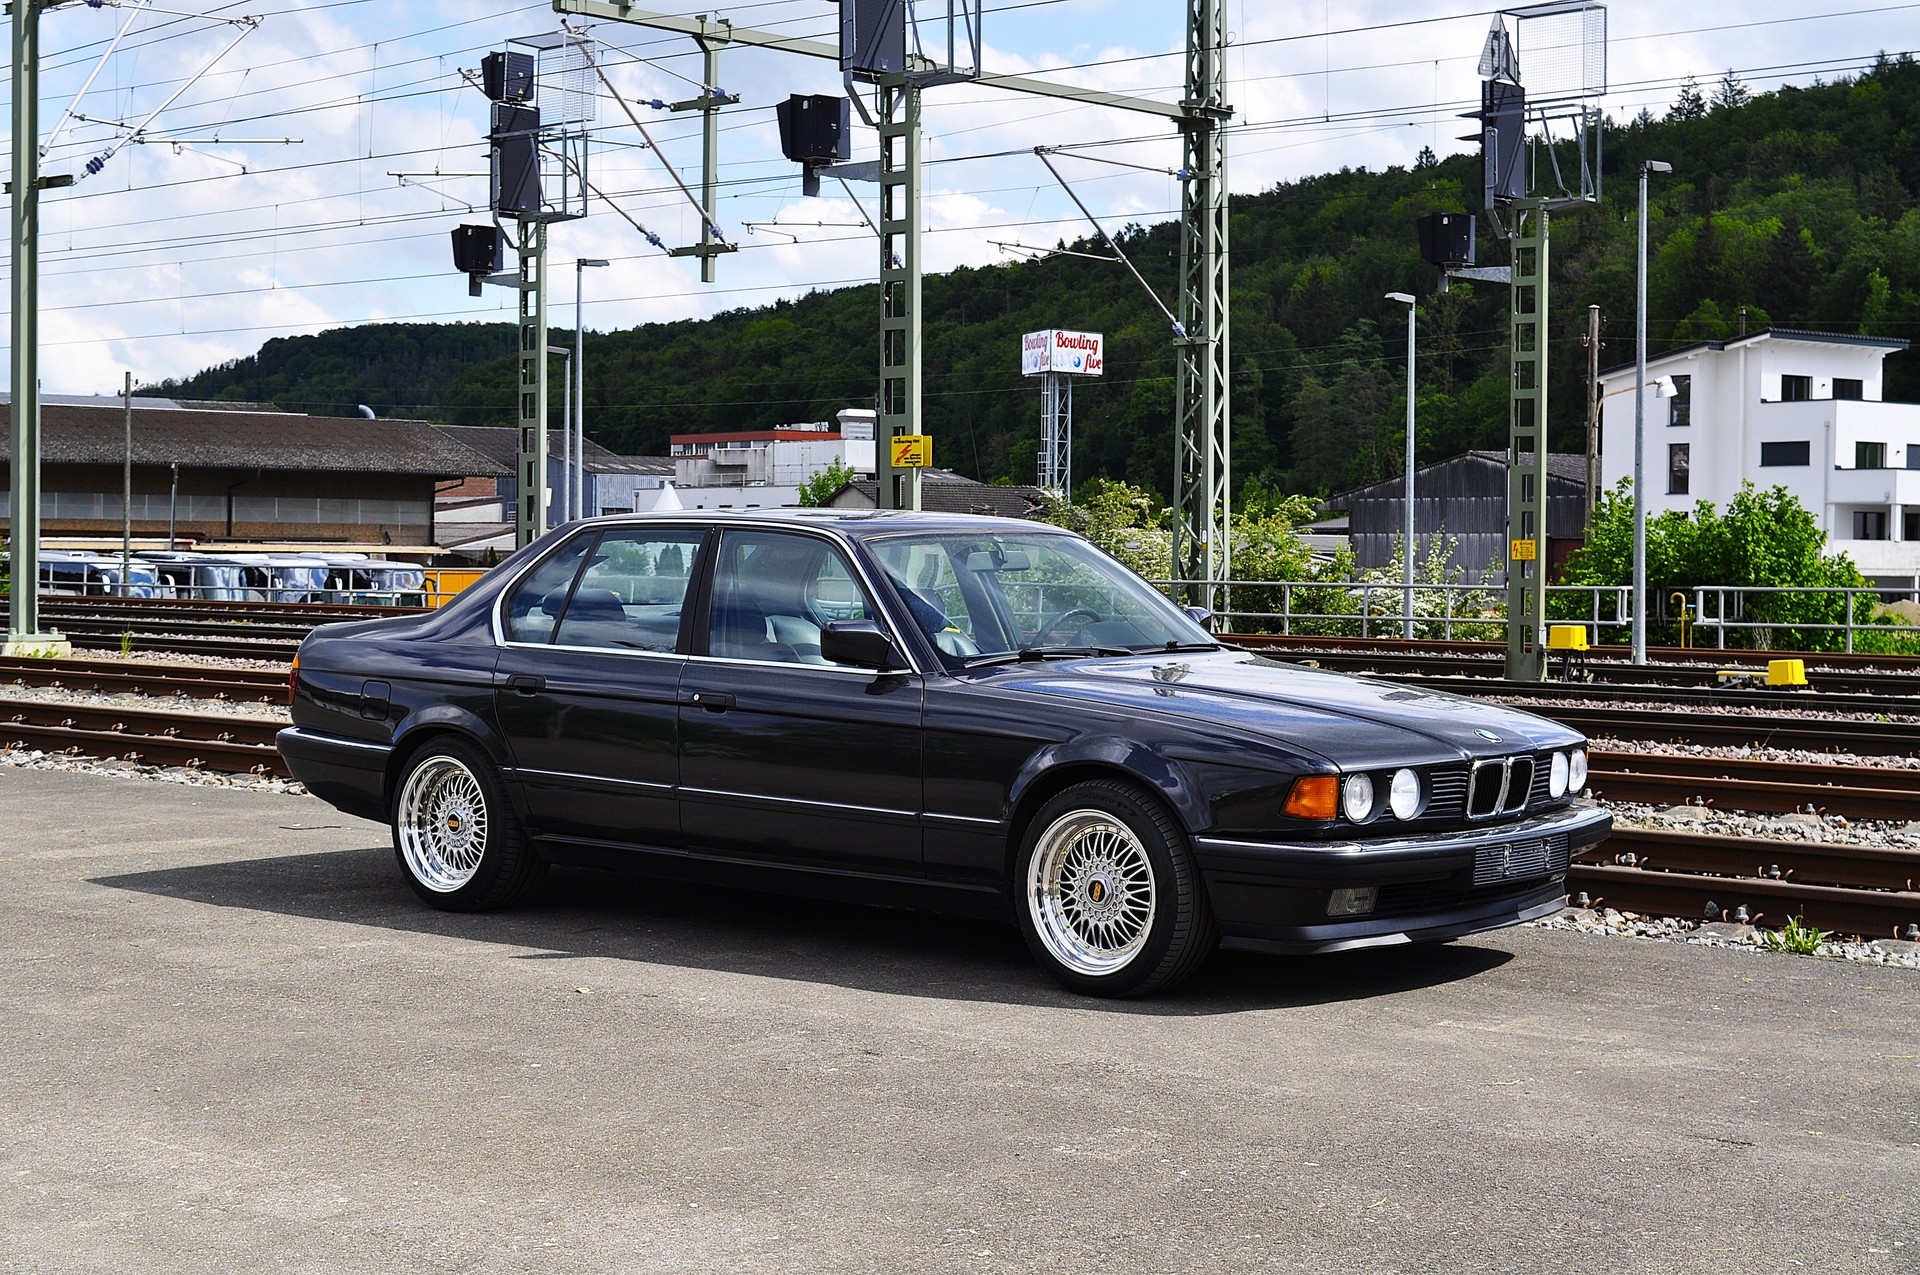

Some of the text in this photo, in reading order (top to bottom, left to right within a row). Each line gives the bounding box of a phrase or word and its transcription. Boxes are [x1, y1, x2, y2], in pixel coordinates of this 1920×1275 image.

[1024, 334, 1048, 352] Bowling
[1056, 331, 1098, 355] Bowling
[1039, 351, 1049, 371] five
[1083, 354, 1102, 372] five
